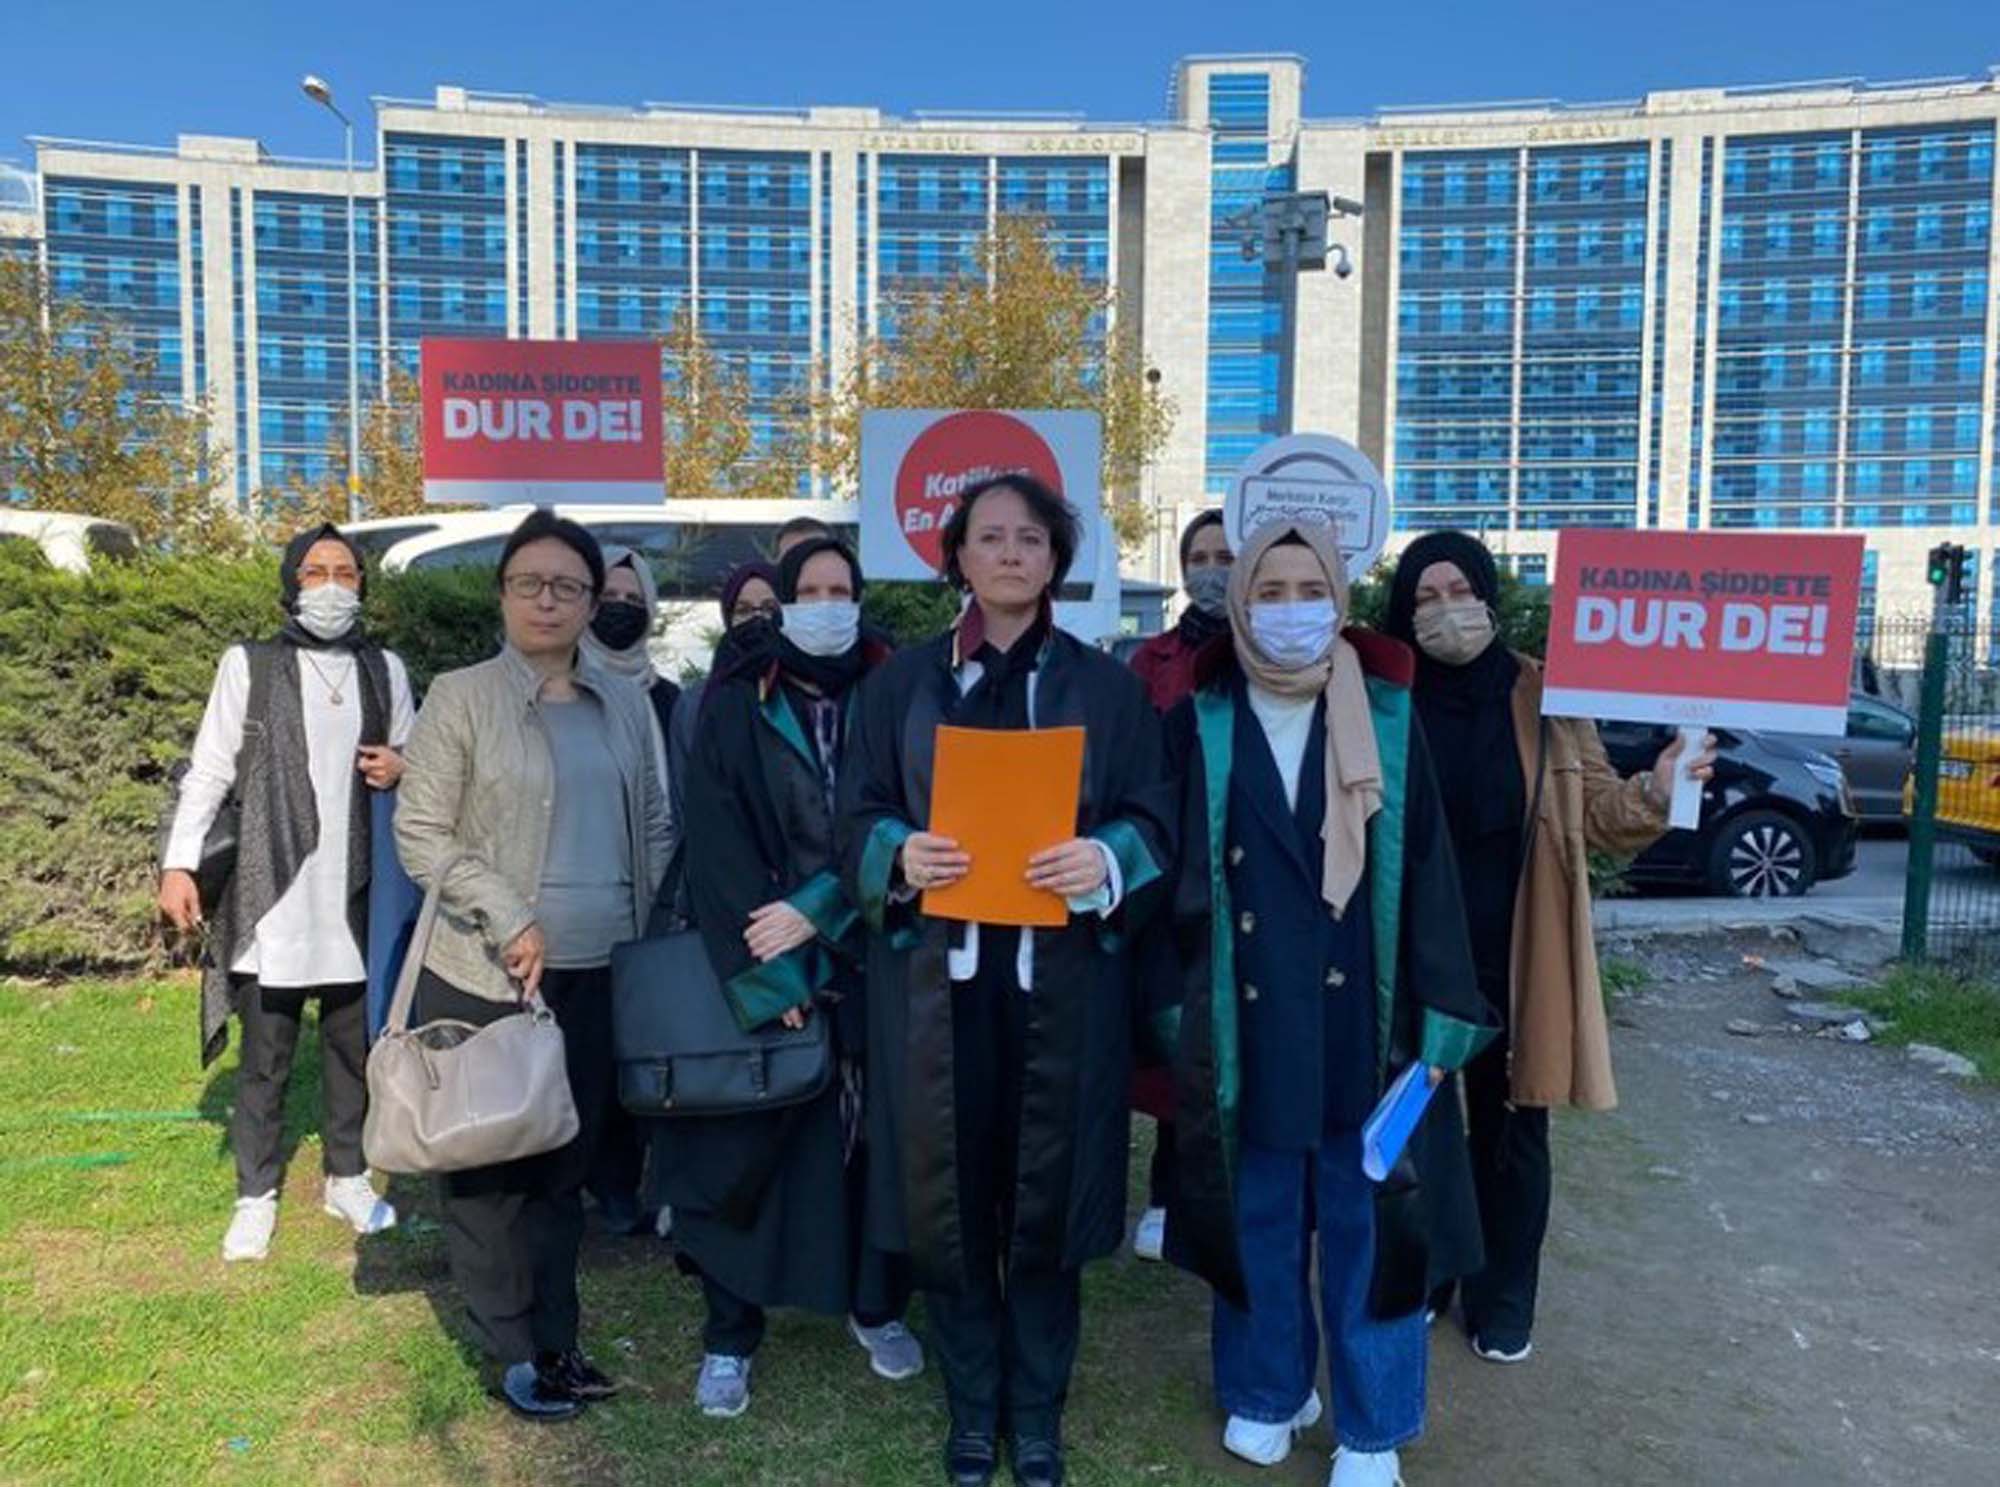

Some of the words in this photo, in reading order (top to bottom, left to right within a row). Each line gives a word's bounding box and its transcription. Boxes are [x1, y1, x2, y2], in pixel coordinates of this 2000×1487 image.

[443, 373, 537, 393] KADINA
[443, 398, 552, 440] DUR
[563, 400, 643, 442] DE!
[905, 507, 933, 532] En
[1580, 567, 1693, 592] KADINA
[1700, 569, 1832, 597] ŞİDDETE
[1574, 596, 1708, 650] DUR
[1720, 602, 1829, 656] DE!
